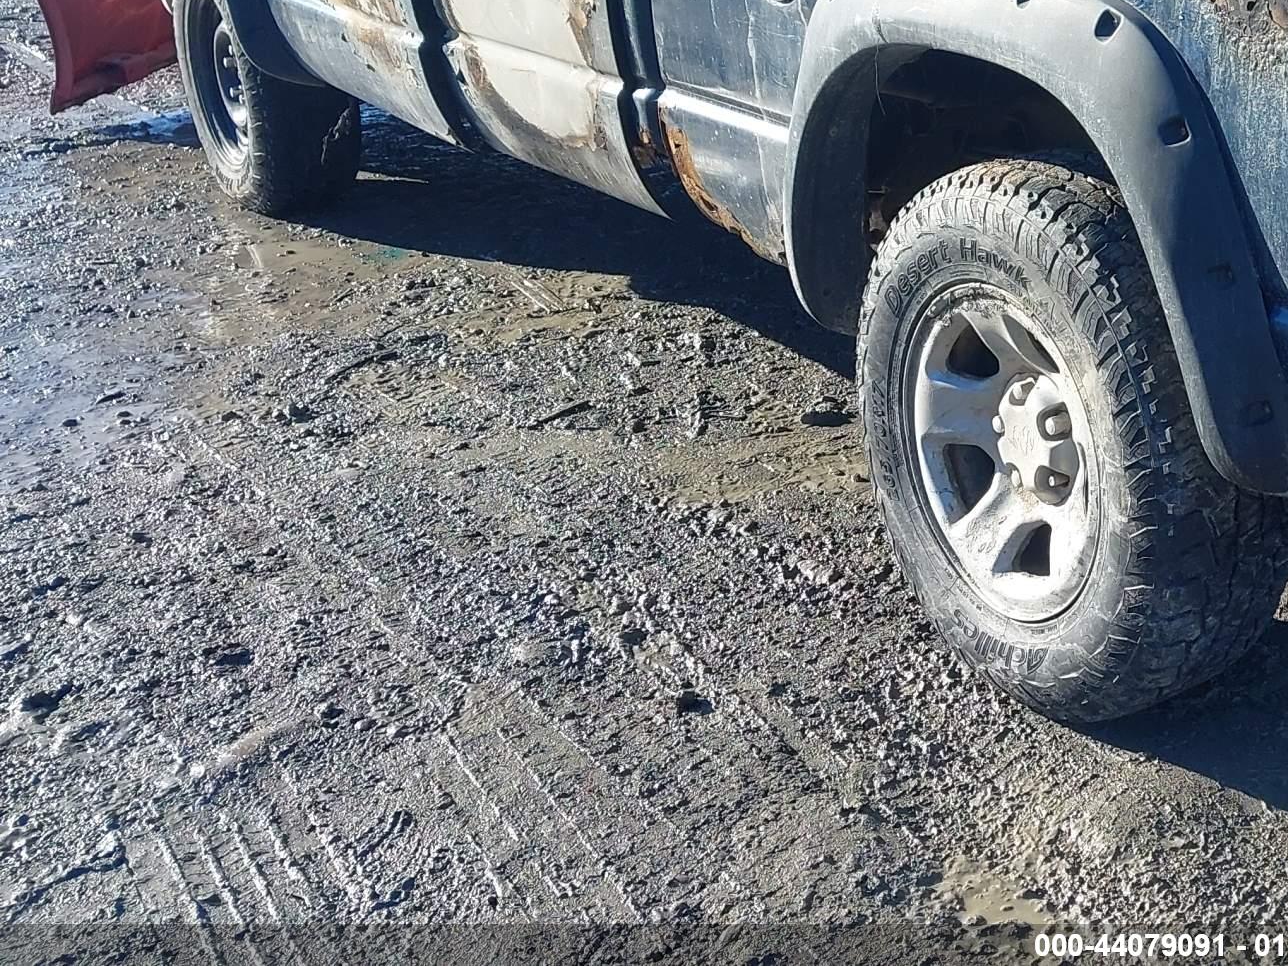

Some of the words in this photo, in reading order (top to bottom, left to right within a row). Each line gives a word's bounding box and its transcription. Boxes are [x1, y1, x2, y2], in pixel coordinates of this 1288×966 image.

[884, 239, 953, 319] Desert
[959, 237, 1032, 287] Hawk
[950, 608, 1050, 675] Achilles
